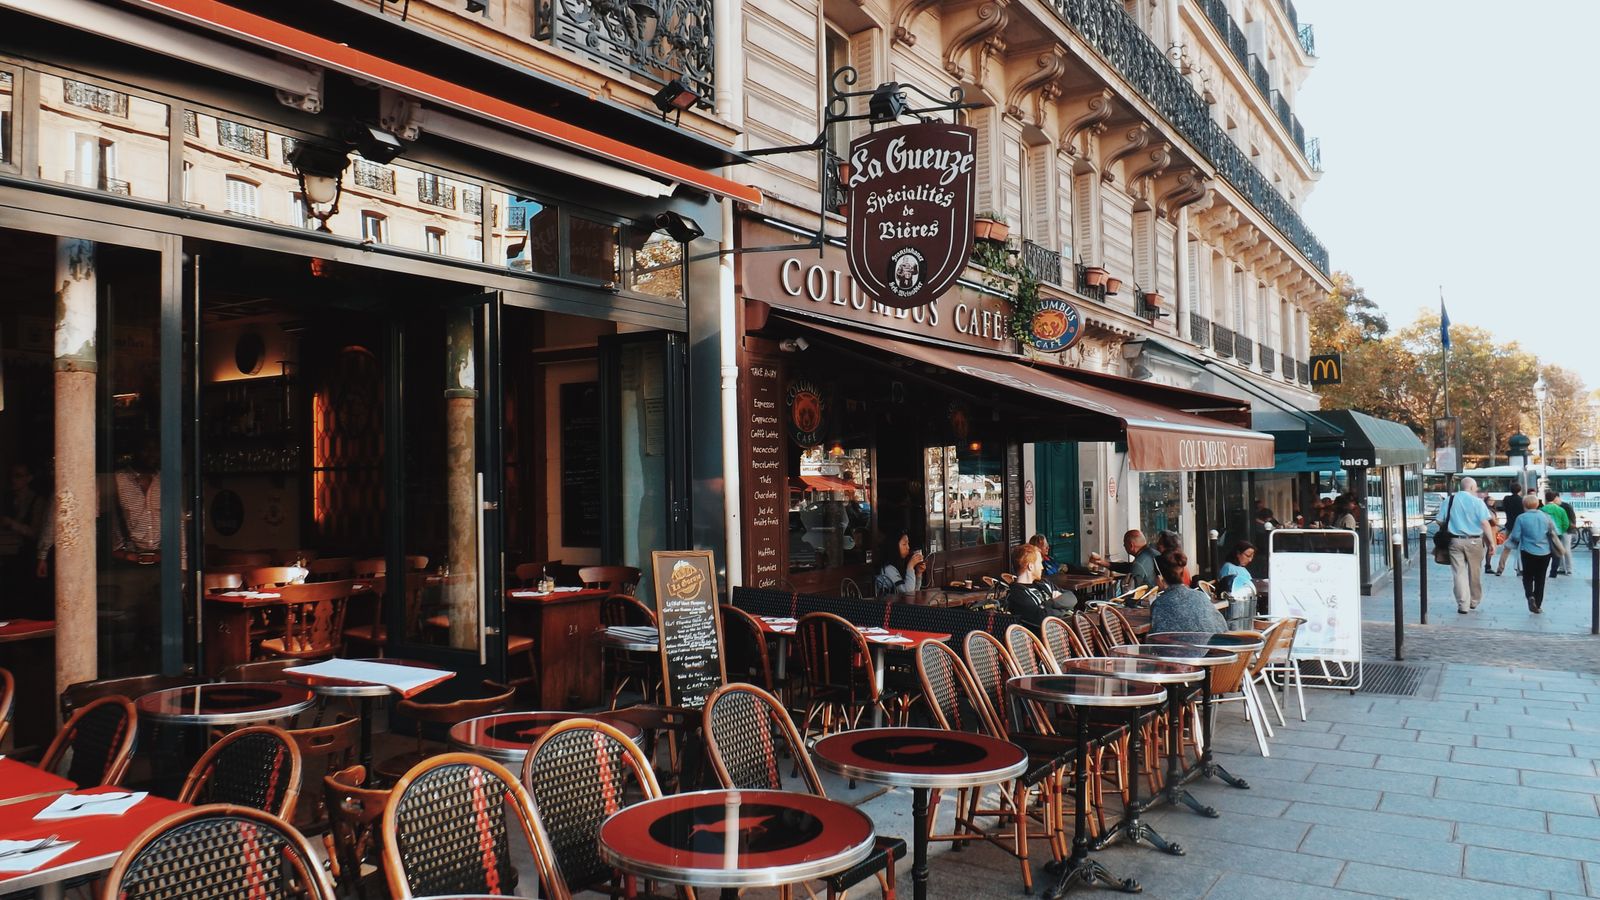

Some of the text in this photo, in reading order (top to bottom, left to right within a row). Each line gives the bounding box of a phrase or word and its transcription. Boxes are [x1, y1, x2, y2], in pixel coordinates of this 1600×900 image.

[849, 135, 974, 188] La Gueuze
[866, 184, 955, 214] Spécialités
[902, 205, 915, 216] de
[878, 219, 940, 241] Bières
[780, 257, 939, 328] COLUUS
[955, 303, 1003, 341] CAFÉ
[1035, 300, 1078, 322] LUMBUS
[750, 367, 764, 377] TAKE
[1179, 439, 1249, 468] COLUMBUS CAFÉ
[1340, 458, 1369, 466] nald's
[757, 547, 776, 557] Muffins
[757, 563, 777, 574] Brownies
[759, 578, 776, 589] Cookies
